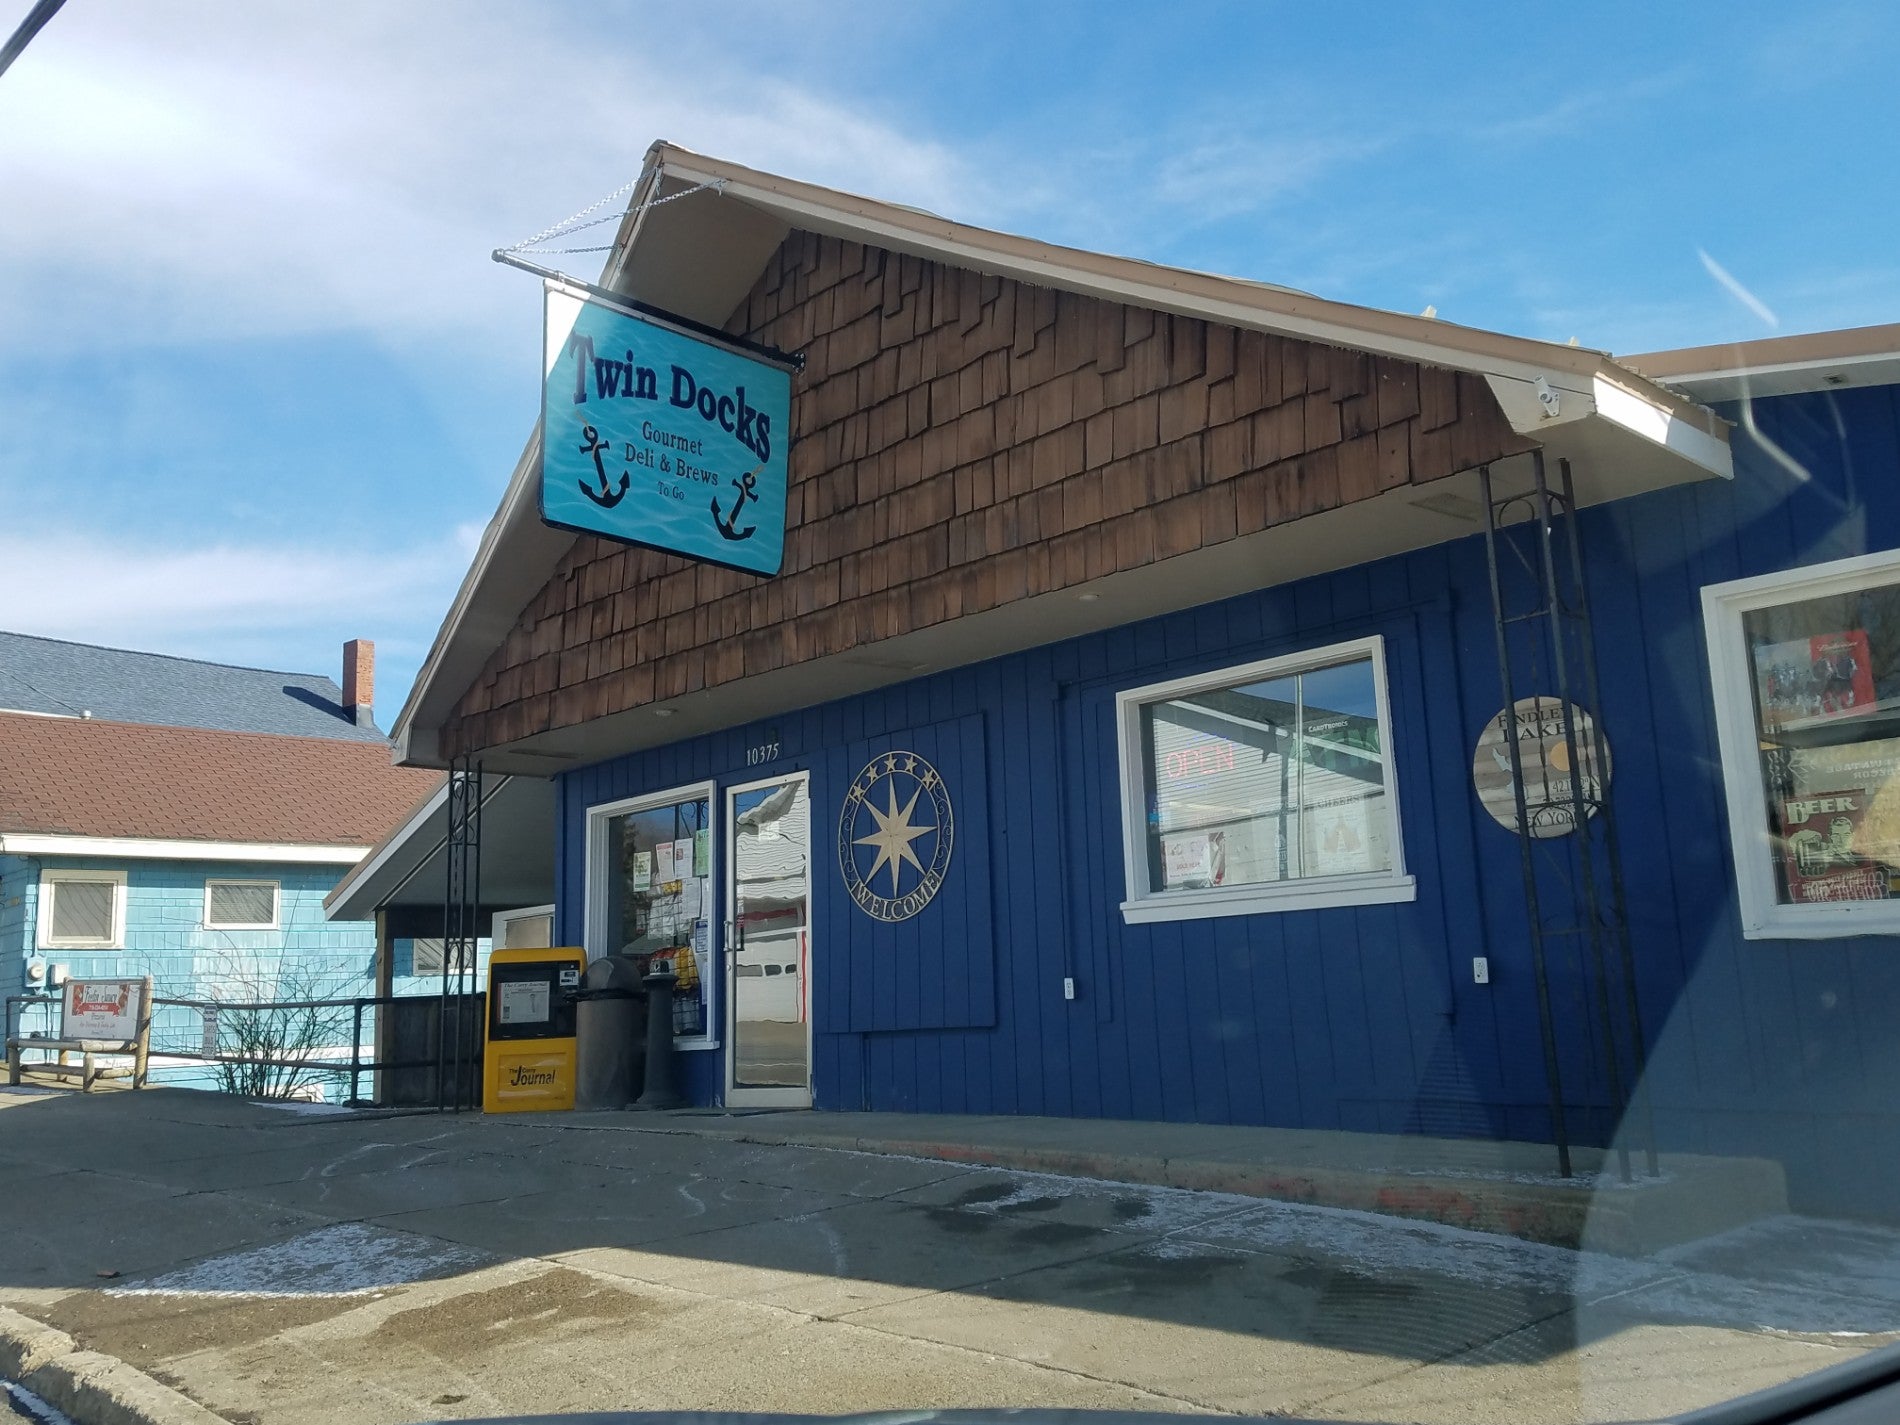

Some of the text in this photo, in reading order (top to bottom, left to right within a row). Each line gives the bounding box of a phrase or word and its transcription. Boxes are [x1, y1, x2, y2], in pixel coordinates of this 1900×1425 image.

[569, 331, 771, 464] Twin Docks
[642, 421, 703, 456] Gourmet
[625, 442, 719, 486] Deli & Brews
[657, 481, 685, 501] To Go
[746, 742, 780, 767] 10375
[1165, 742, 1234, 778] OPEN
[1786, 797, 1859, 824] BEER
[857, 873, 940, 920] WELCOME
[510, 1065, 556, 1086] Journal
